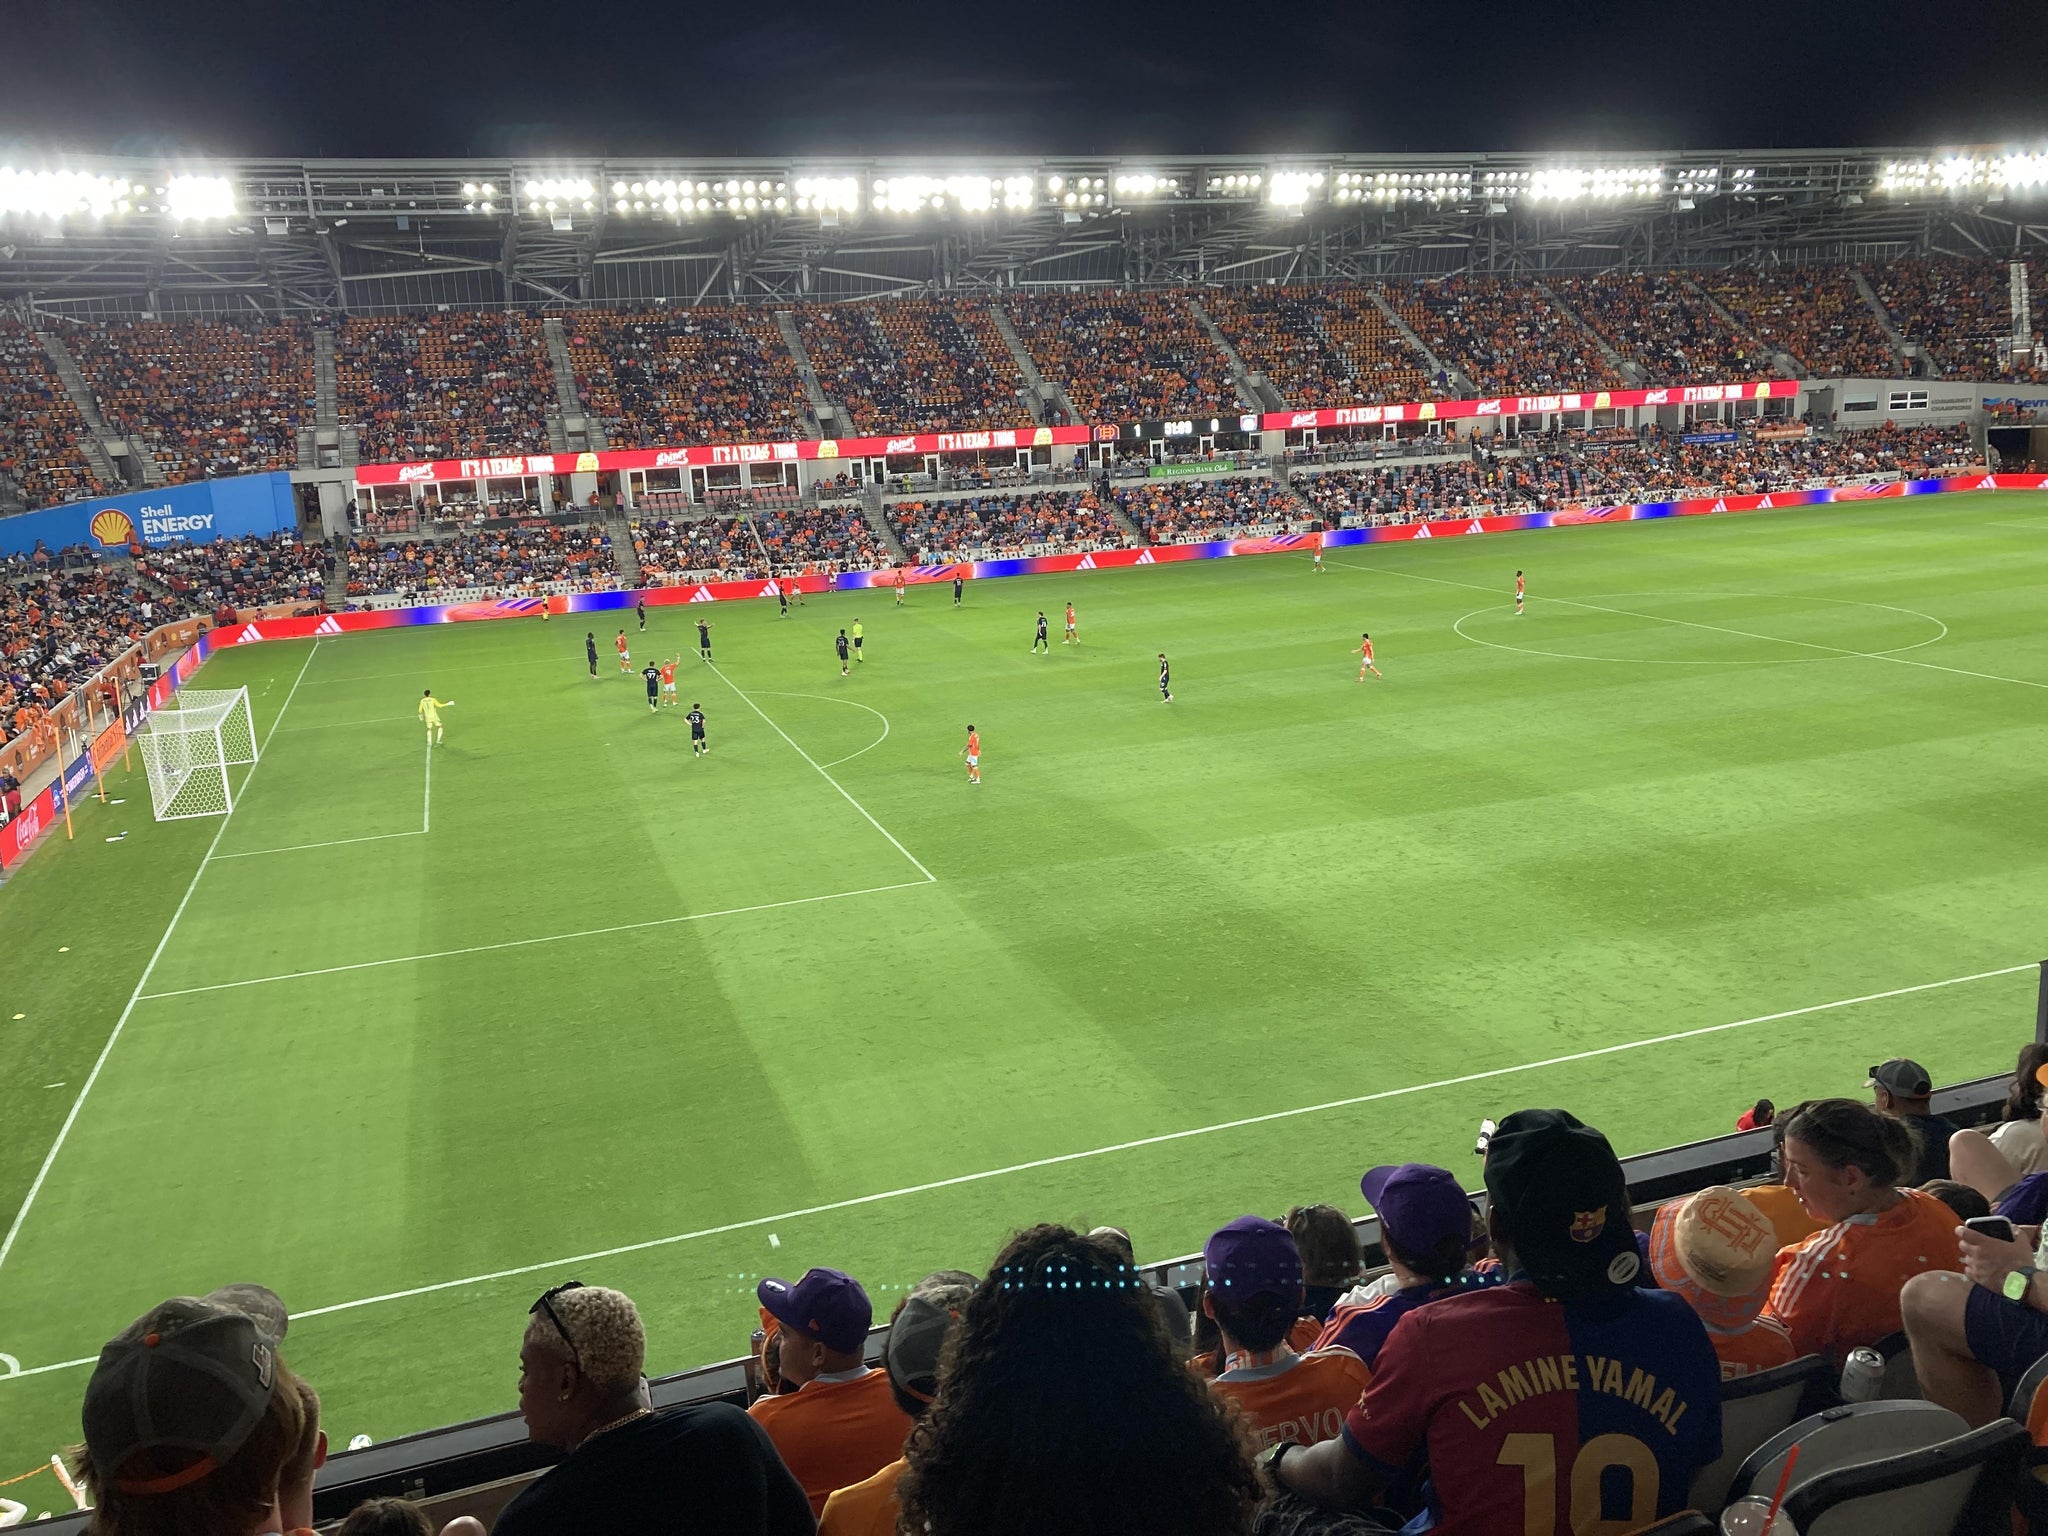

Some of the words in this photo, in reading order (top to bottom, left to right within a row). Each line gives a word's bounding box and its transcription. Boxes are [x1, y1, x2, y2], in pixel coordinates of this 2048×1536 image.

[1134, 424, 1141, 437] 1
[1167, 467, 1195, 475] REGIONS
[1214, 464, 1228, 472] Club
[140, 504, 172, 518] Shell
[142, 513, 214, 535] ENERGY
[518, 518, 550, 528] verizon
[144, 533, 185, 543] Stadium
[1458, 1355, 1580, 1431] LAMINE
[1586, 1357, 1687, 1436] YAMAL
